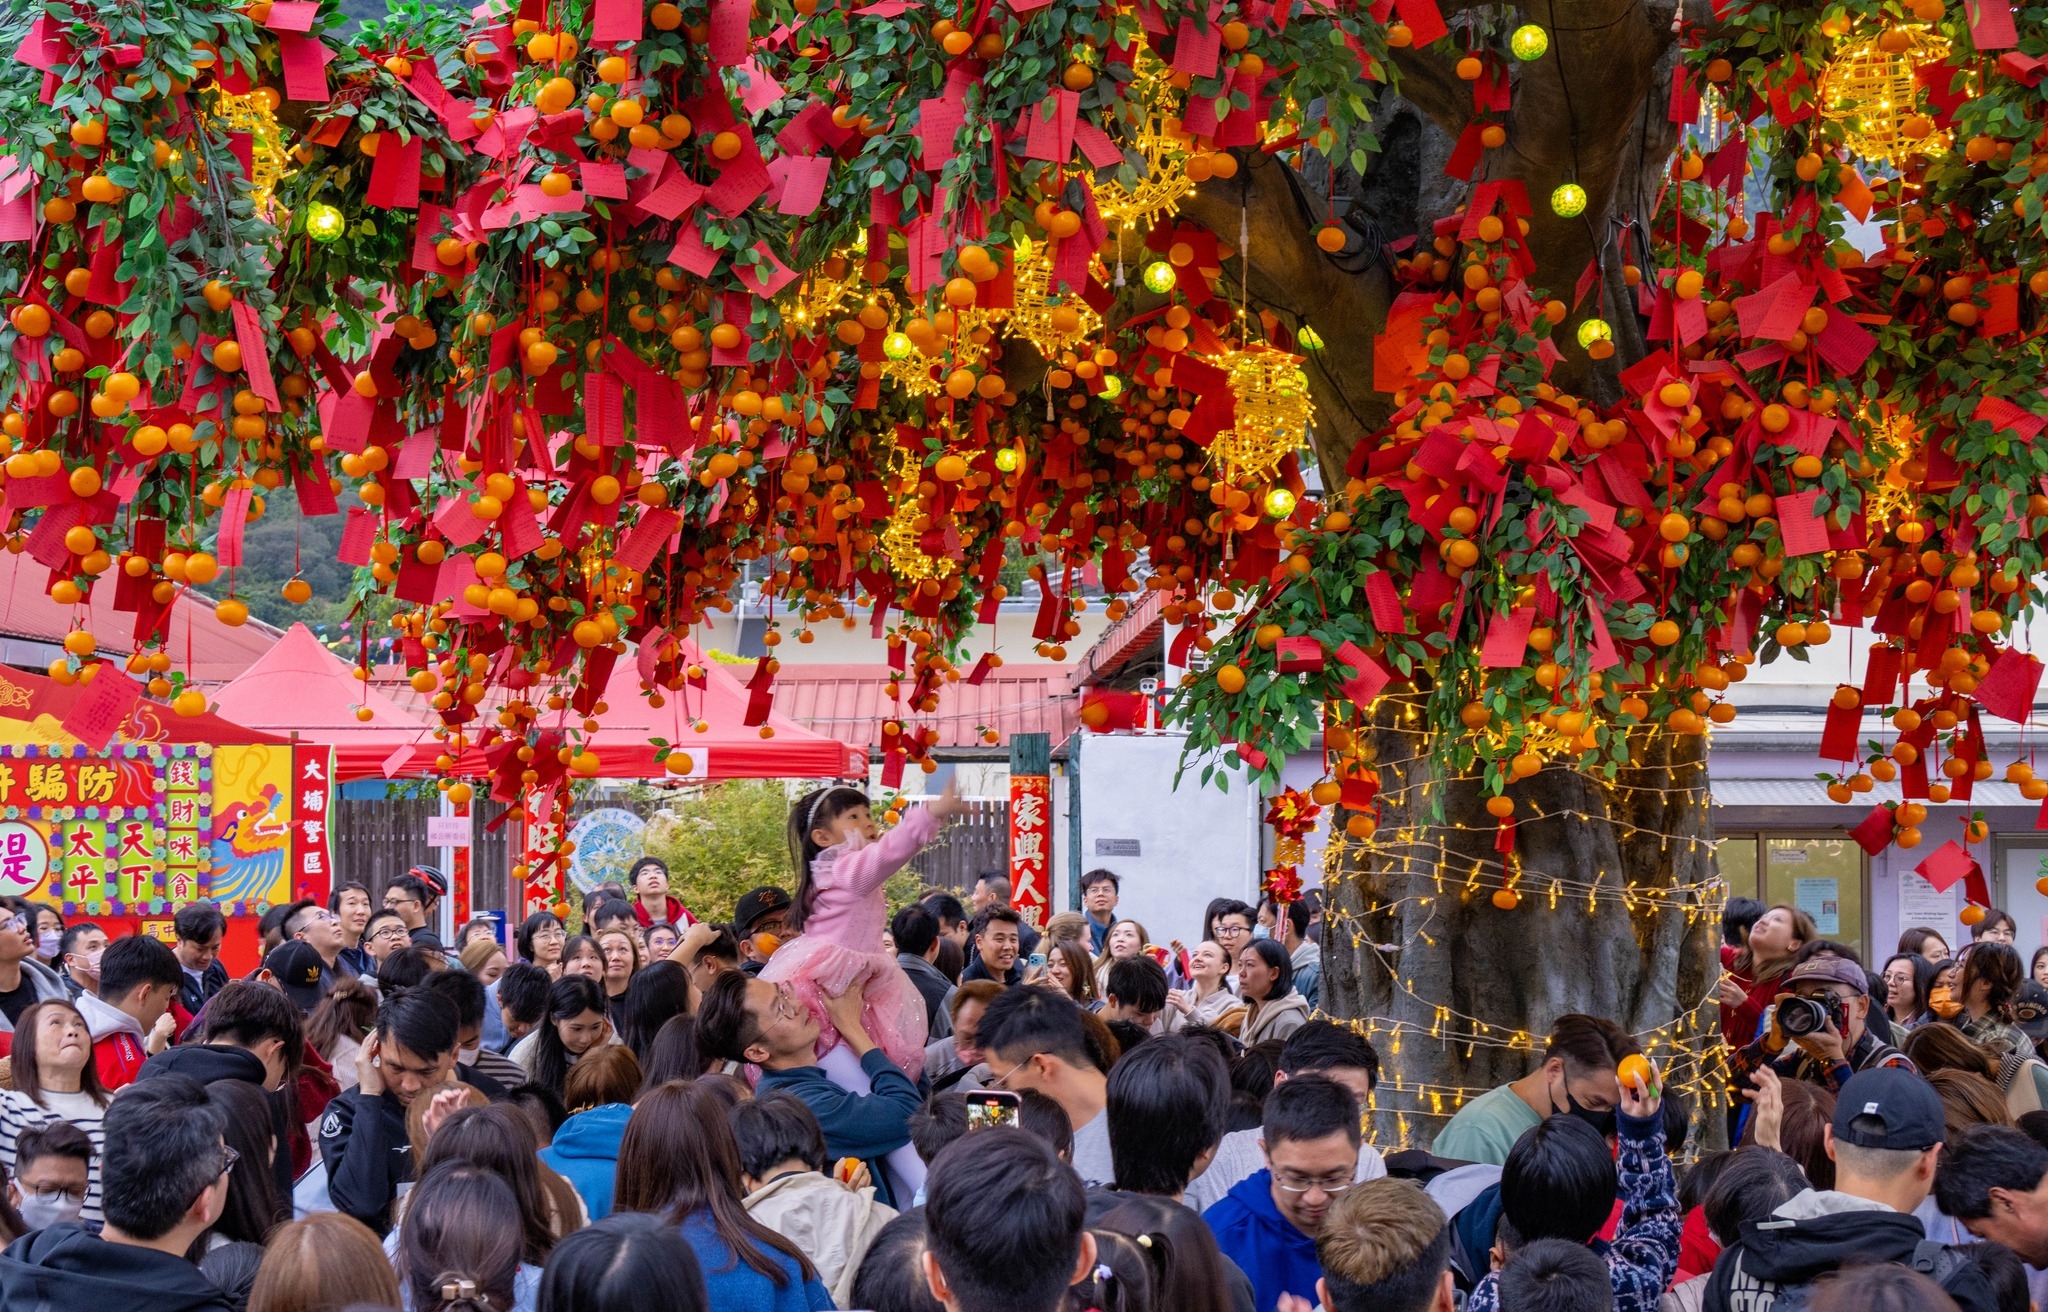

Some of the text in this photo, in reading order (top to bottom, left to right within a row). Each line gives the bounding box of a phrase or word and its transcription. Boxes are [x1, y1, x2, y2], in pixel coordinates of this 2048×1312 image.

[66, 823, 103, 901] 太平
[120, 823, 153, 899] 天下
[170, 760, 195, 899] 錢財咪貪
[303, 759, 326, 873] 大埔警區
[1011, 793, 1047, 933] 家興人興
